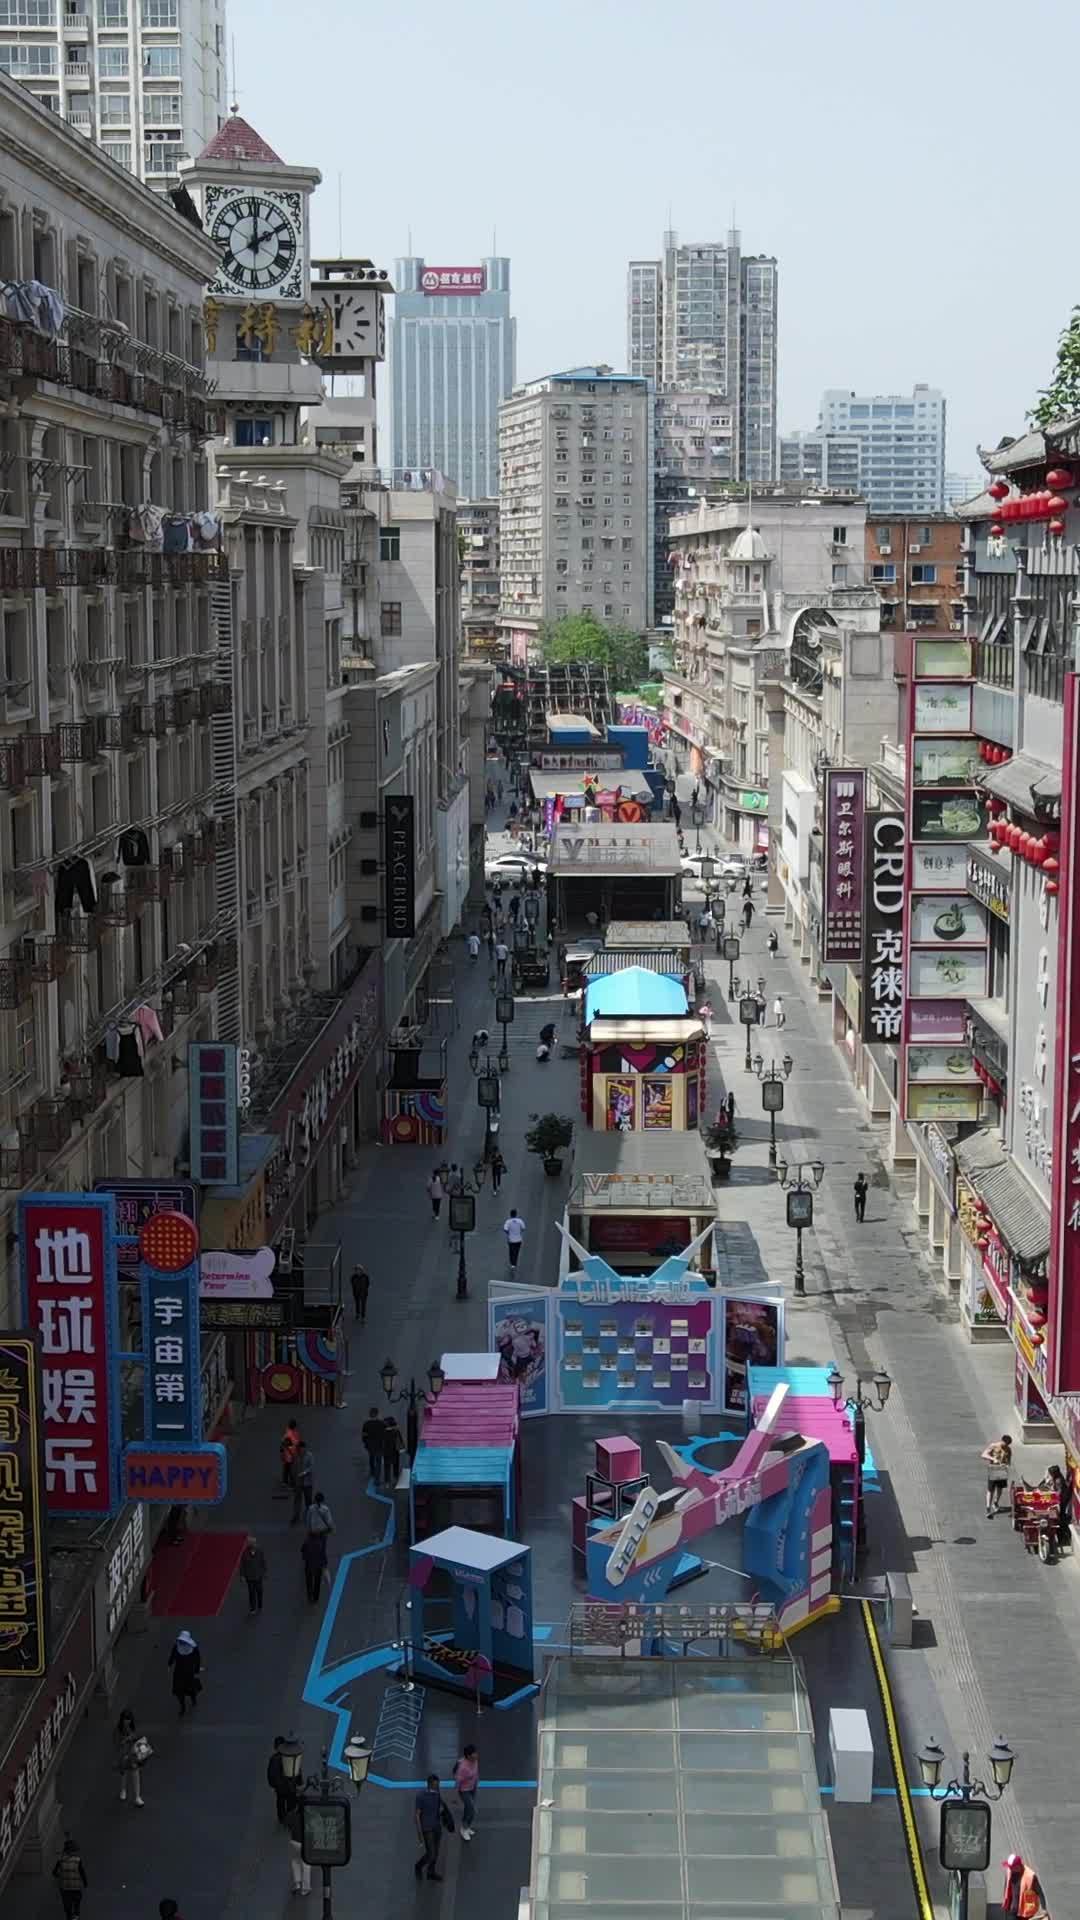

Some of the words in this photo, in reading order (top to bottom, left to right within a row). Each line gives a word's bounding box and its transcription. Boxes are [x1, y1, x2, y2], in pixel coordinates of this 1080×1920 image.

[393, 831, 407, 929] PEACEBIRD
[835, 802, 855, 899] 卫尔斯眼科
[873, 817, 905, 914] CRD
[871, 929, 904, 1038] 克徕帝
[35, 1226, 98, 1495] 地球娱乐
[153, 1297, 186, 1431] 宇宙第一
[128, 1465, 213, 1489] HAPPY
[615, 1501, 654, 1575] HELLO
